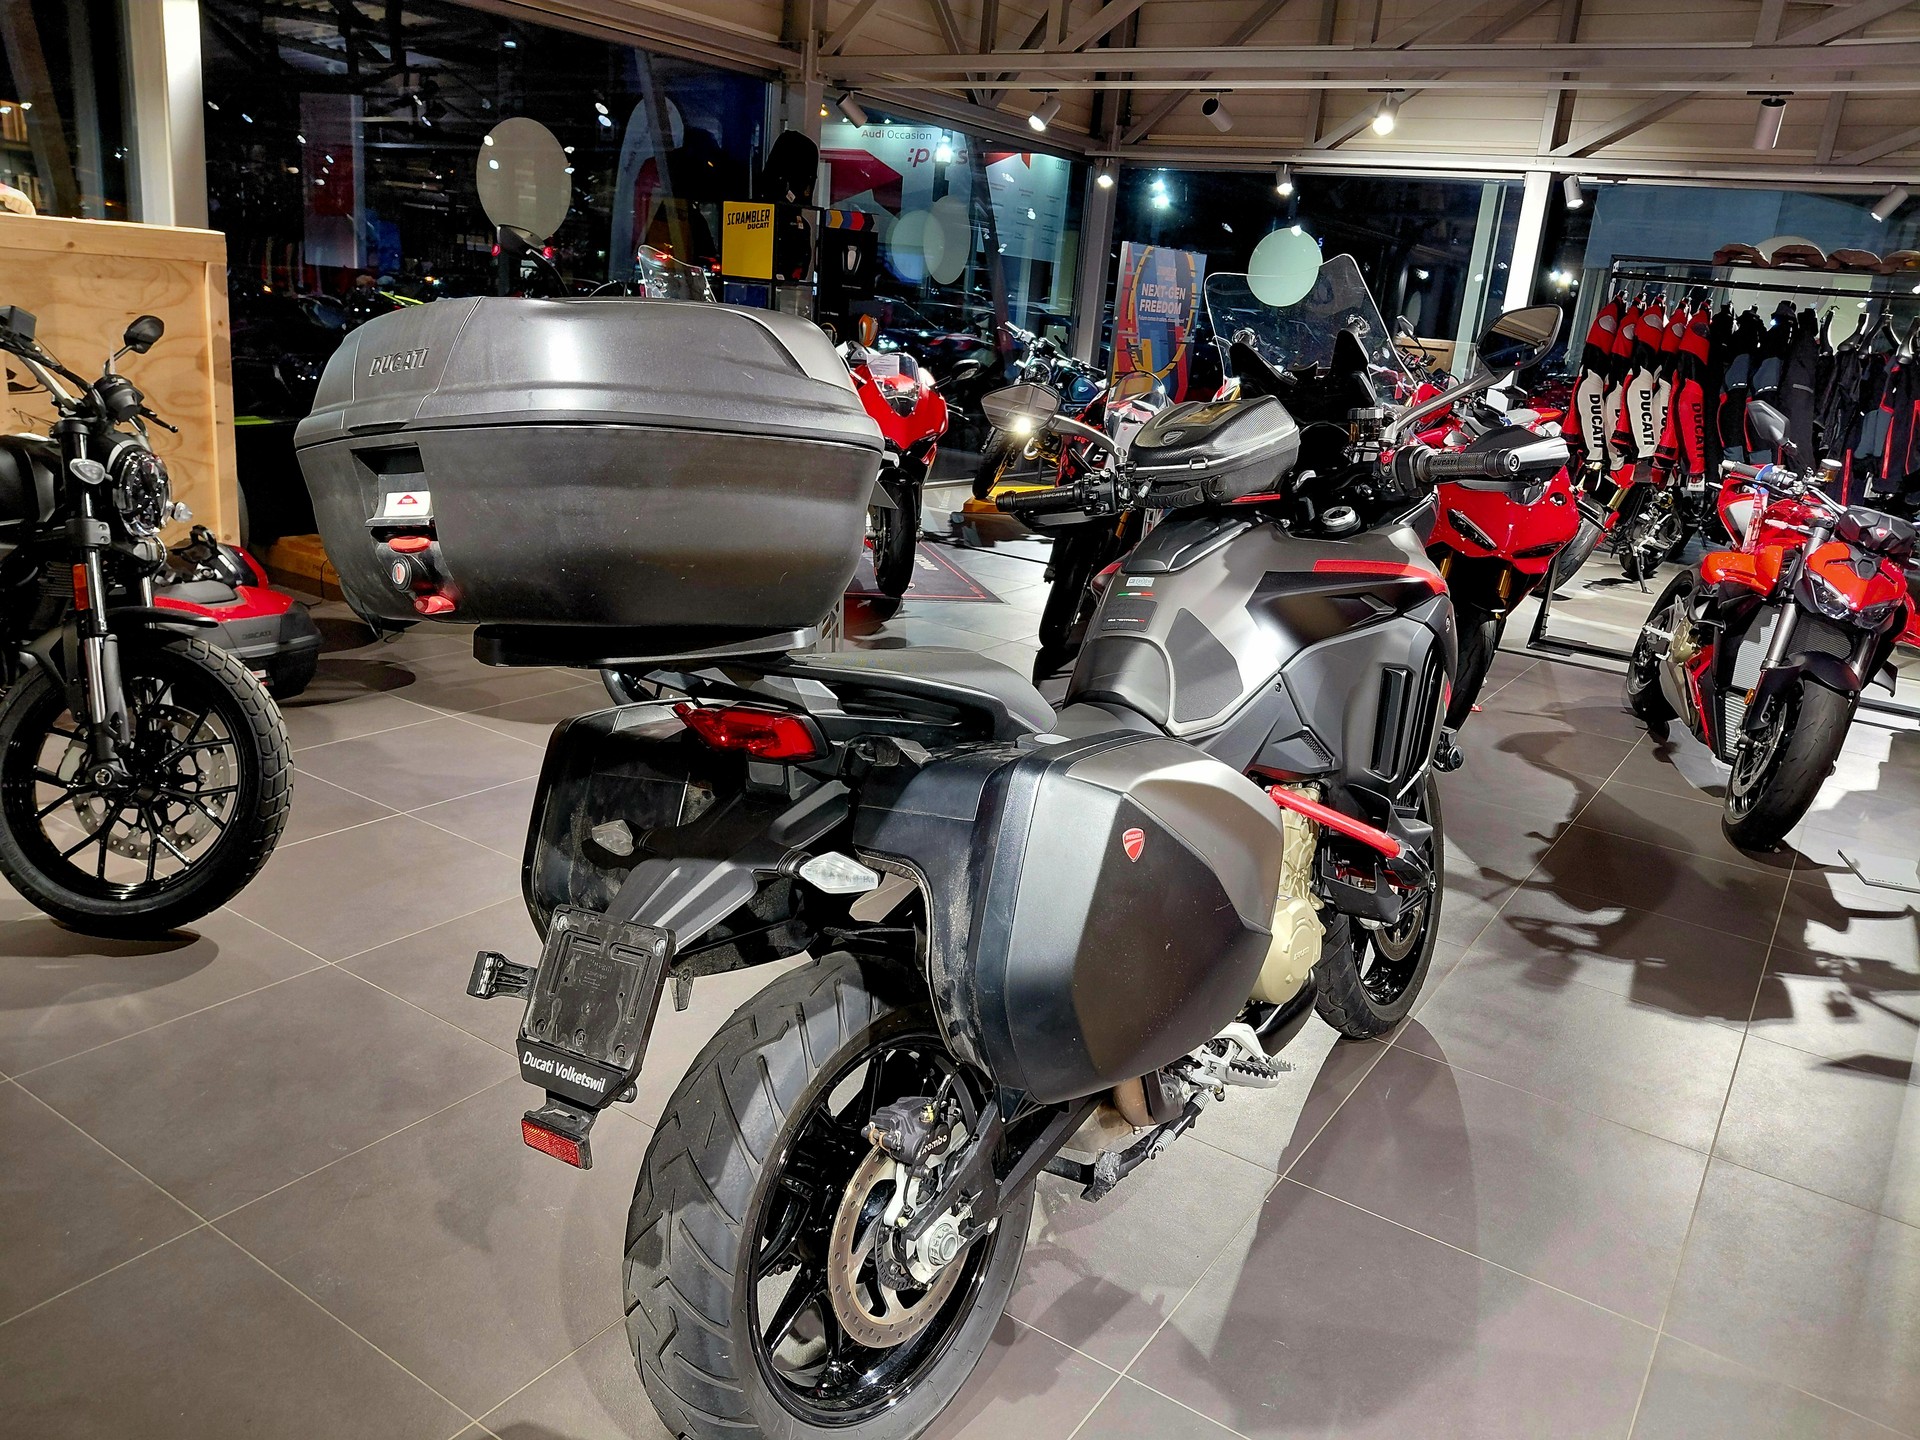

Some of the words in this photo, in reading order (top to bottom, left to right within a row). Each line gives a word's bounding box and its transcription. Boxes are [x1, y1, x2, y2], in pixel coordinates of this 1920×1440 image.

[862, 129, 885, 139] Audi
[887, 129, 932, 140] Occasion
[907, 147, 969, 167] :ps
[727, 209, 770, 226] SCRAMBLER
[747, 222, 769, 230] DUCATI
[1141, 283, 1186, 300] NEXT-GEN
[1139, 299, 1182, 315] FREEDOM
[368, 347, 430, 377] DUCATI
[1589, 394, 1604, 448] DUCATI
[1640, 390, 1654, 445] DUCATI
[1691, 403, 1705, 458] DUCATI
[522, 1051, 555, 1074] Ducati
[555, 1062, 606, 1093] Volketswil
[918, 1134, 948, 1157] rembo
